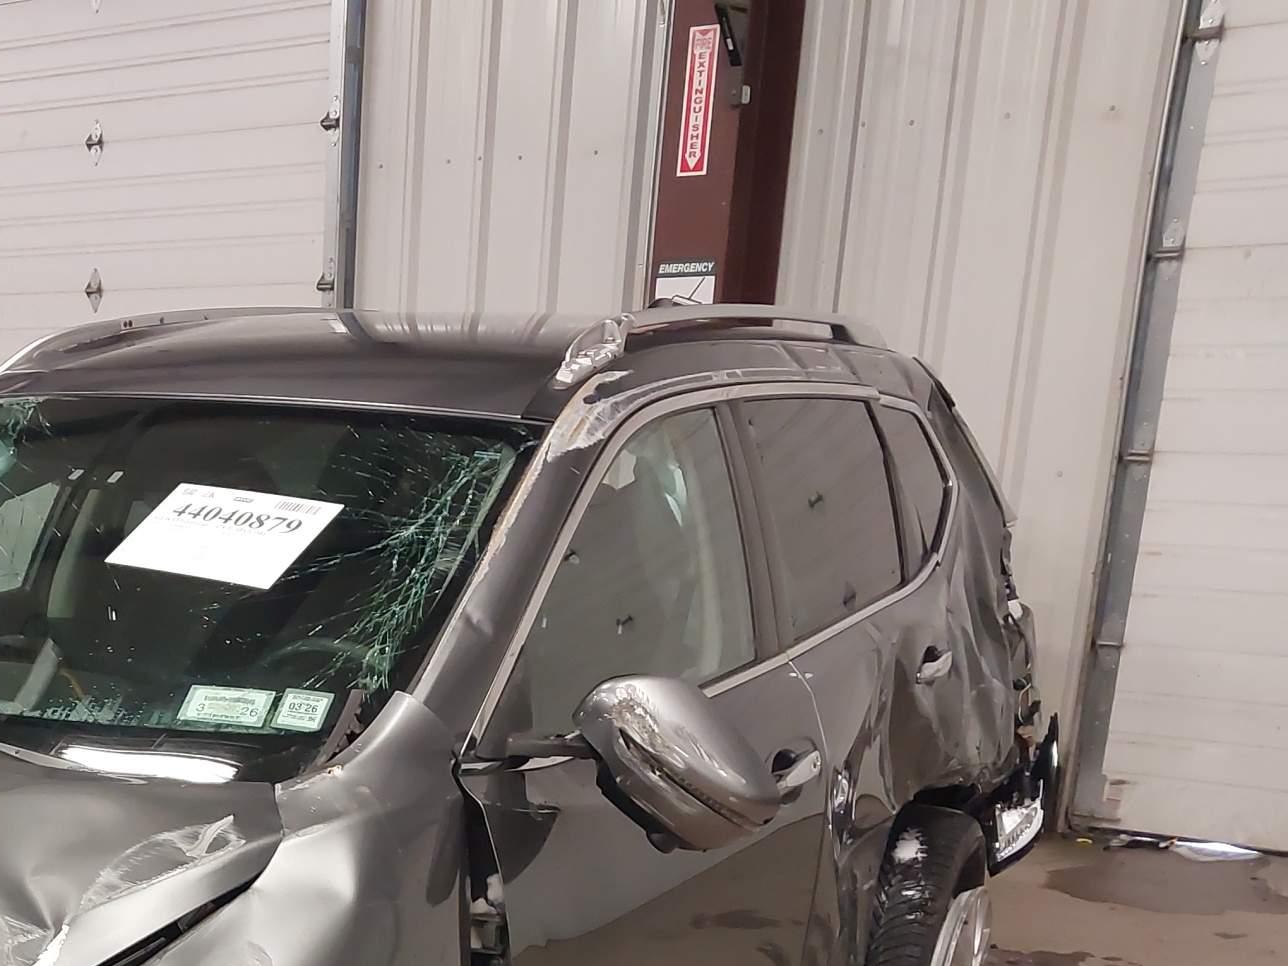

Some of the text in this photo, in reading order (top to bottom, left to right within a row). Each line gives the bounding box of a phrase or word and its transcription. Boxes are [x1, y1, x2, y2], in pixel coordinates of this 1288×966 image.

[688, 51, 708, 158] EXTINGUISHER
[658, 262, 715, 274] EMERGENCY
[172, 502, 303, 534] 44040879
[239, 706, 259, 717] 26
